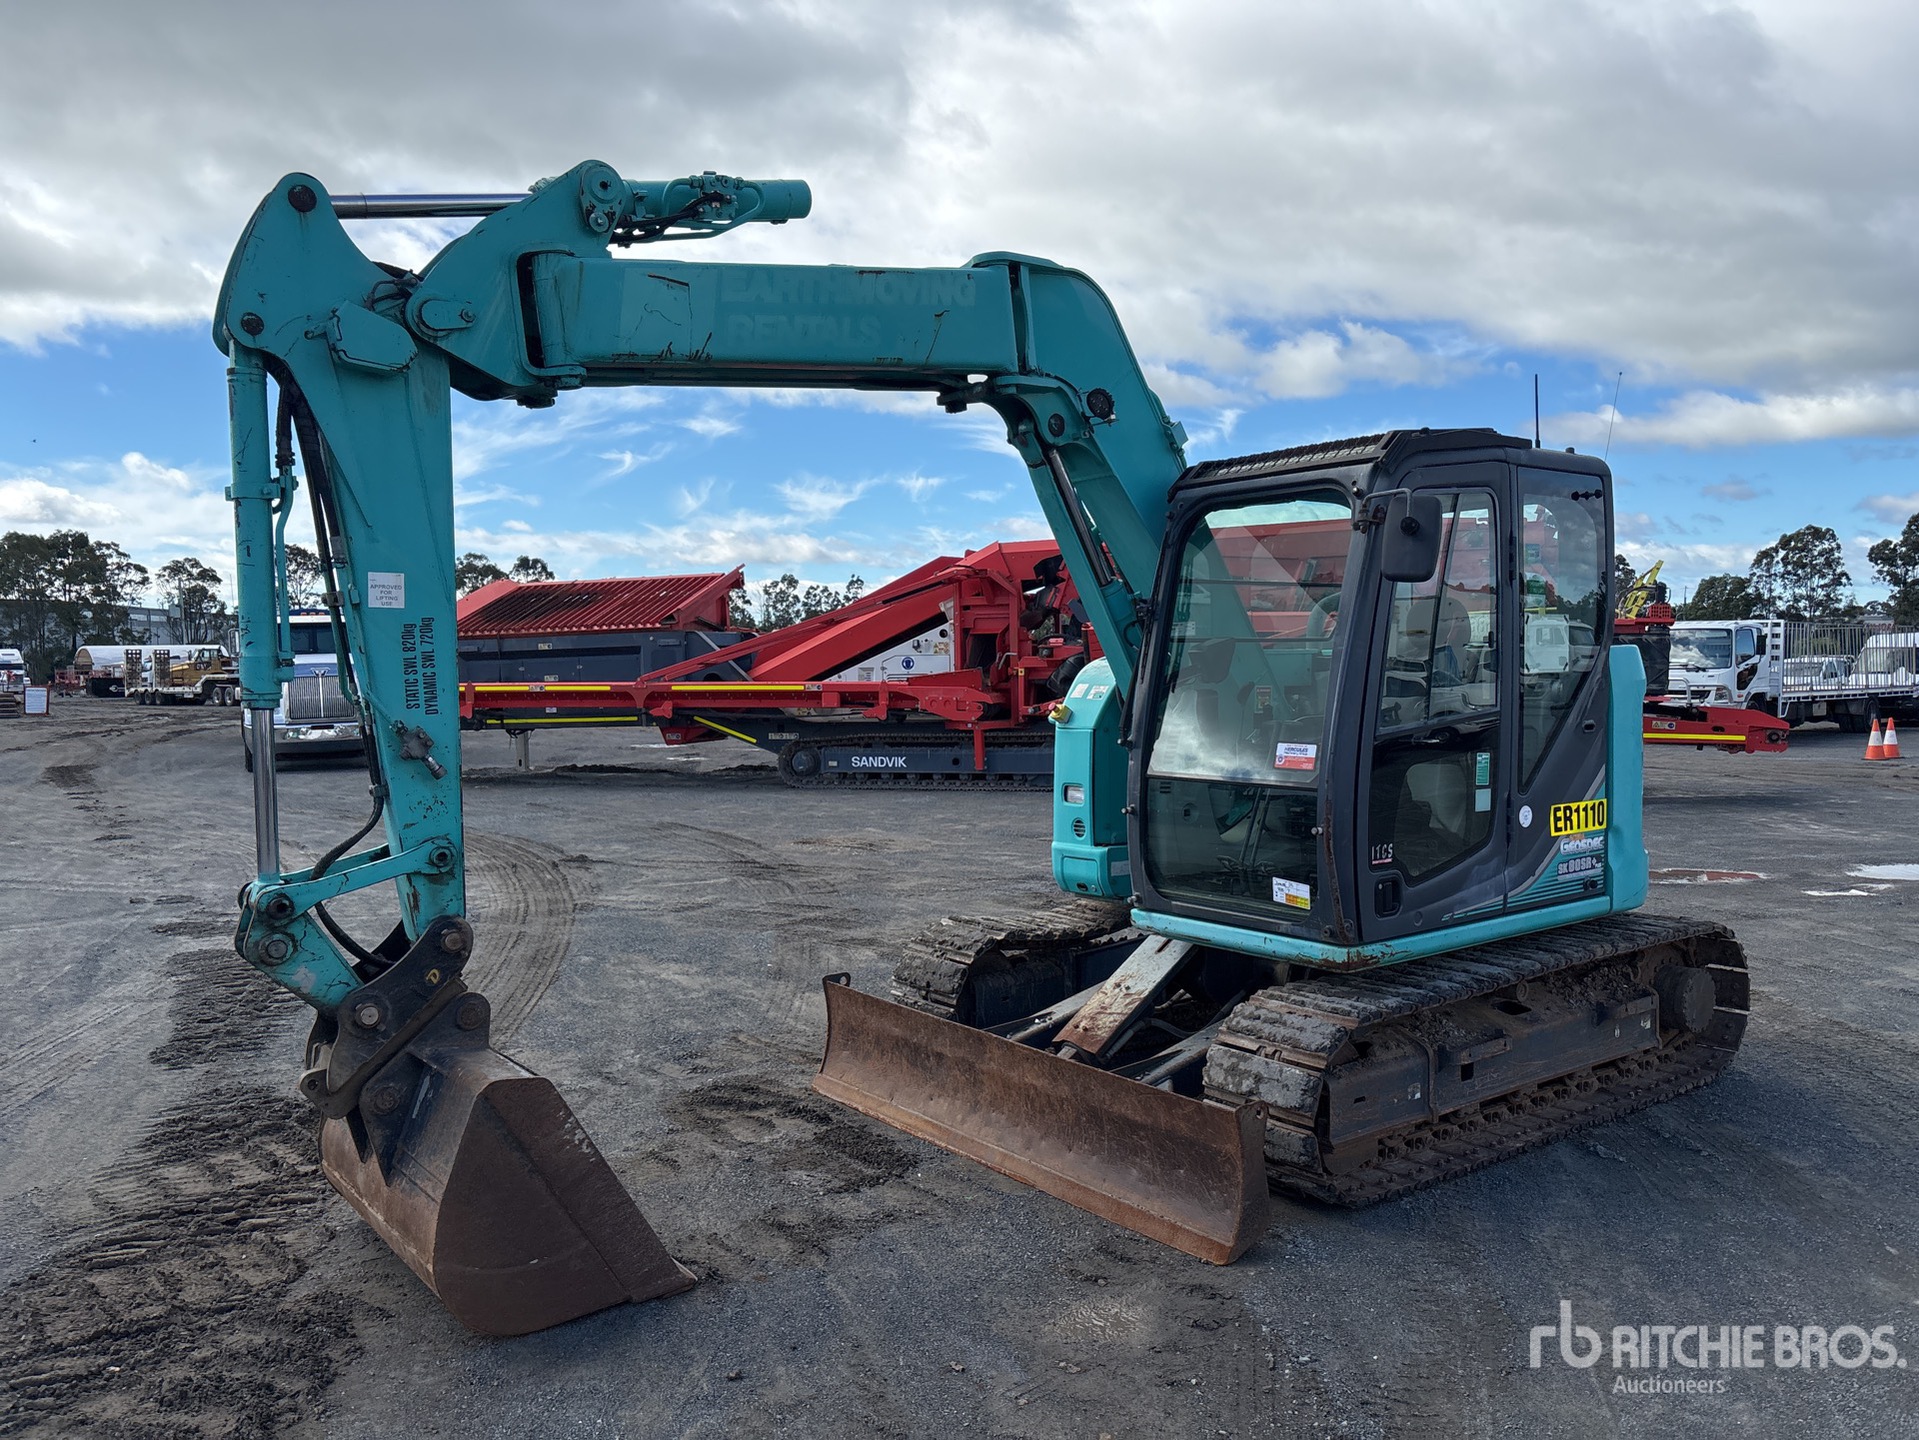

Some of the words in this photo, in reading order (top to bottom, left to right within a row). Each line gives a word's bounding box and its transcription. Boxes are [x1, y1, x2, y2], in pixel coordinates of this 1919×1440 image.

[726, 313, 882, 349] RENTALS
[401, 623, 417, 653] 820kg
[419, 617, 435, 646] 720kg
[403, 655, 418, 675] SWL
[421, 648, 436, 669] SWL
[405, 677, 421, 710] STATIC
[422, 671, 439, 716] DYNAMIC
[851, 756, 907, 768] SANDVIK
[1552, 800, 1605, 833] ER1110
